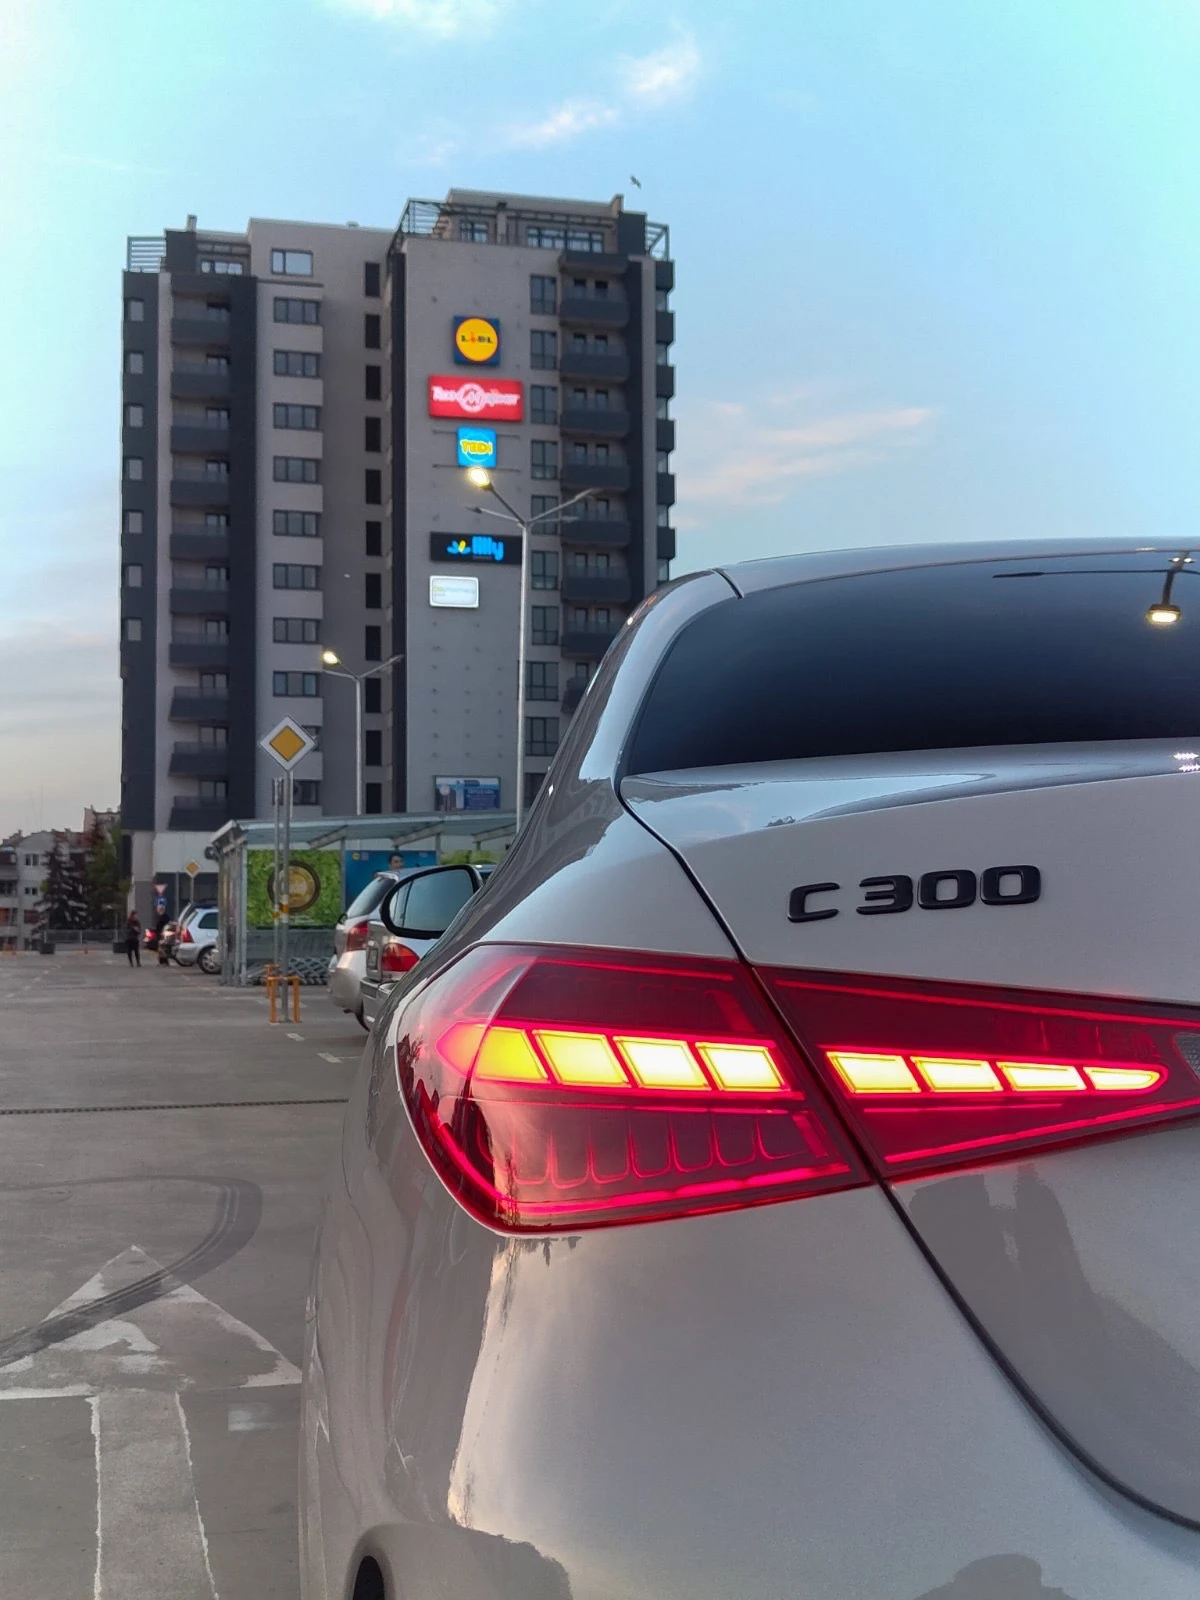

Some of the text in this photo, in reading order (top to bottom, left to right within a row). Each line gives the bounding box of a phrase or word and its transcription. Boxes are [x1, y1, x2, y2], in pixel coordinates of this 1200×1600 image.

[472, 536, 505, 561] lilly
[787, 865, 1041, 923] C 300
